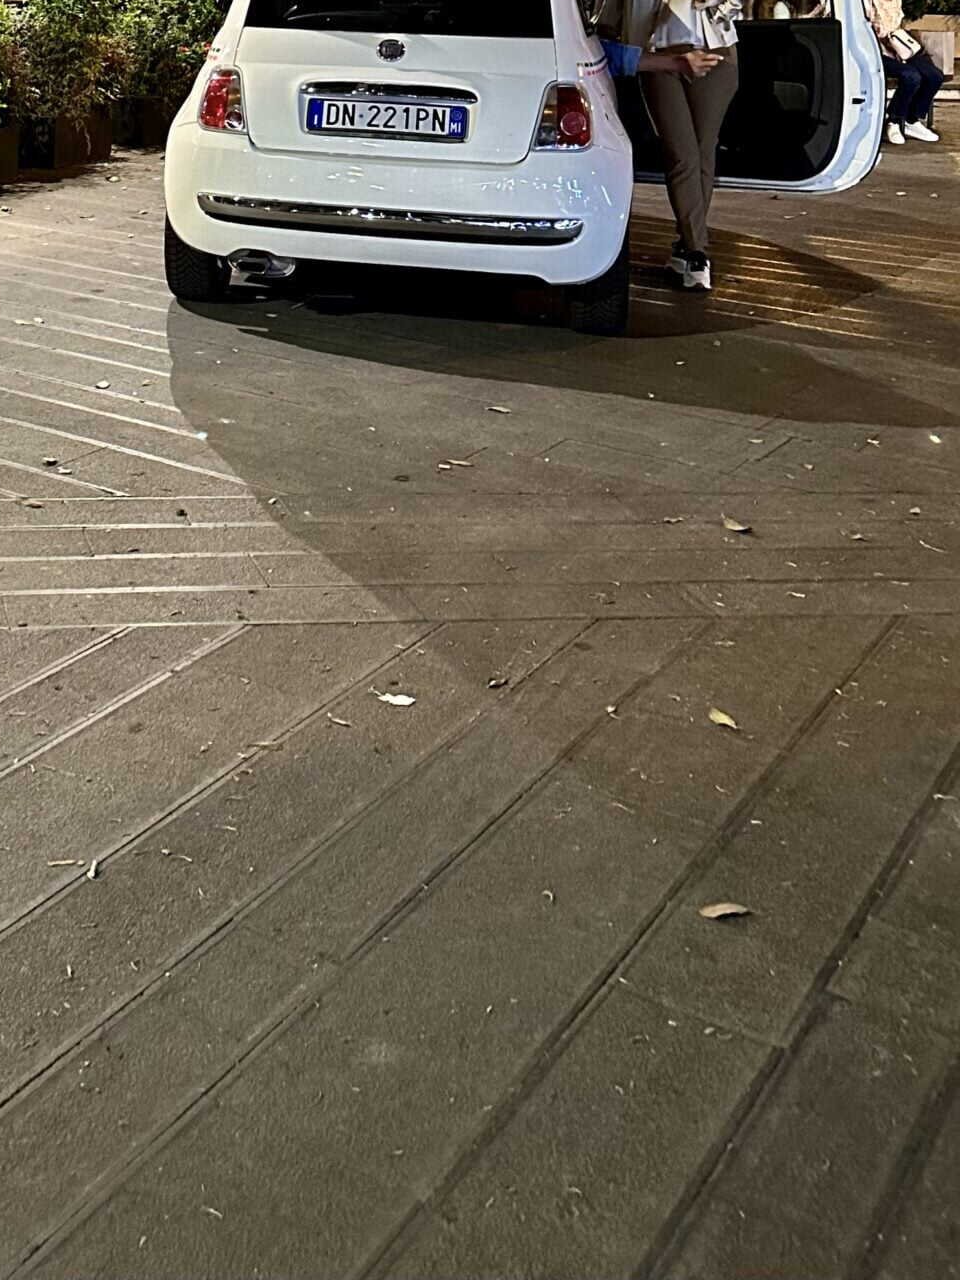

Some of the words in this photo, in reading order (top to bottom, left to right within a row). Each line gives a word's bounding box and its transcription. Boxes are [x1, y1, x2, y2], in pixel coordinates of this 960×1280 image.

[326, 103, 356, 126] DN
[367, 105, 446, 133] 221PN
[449, 121, 462, 133] MI
